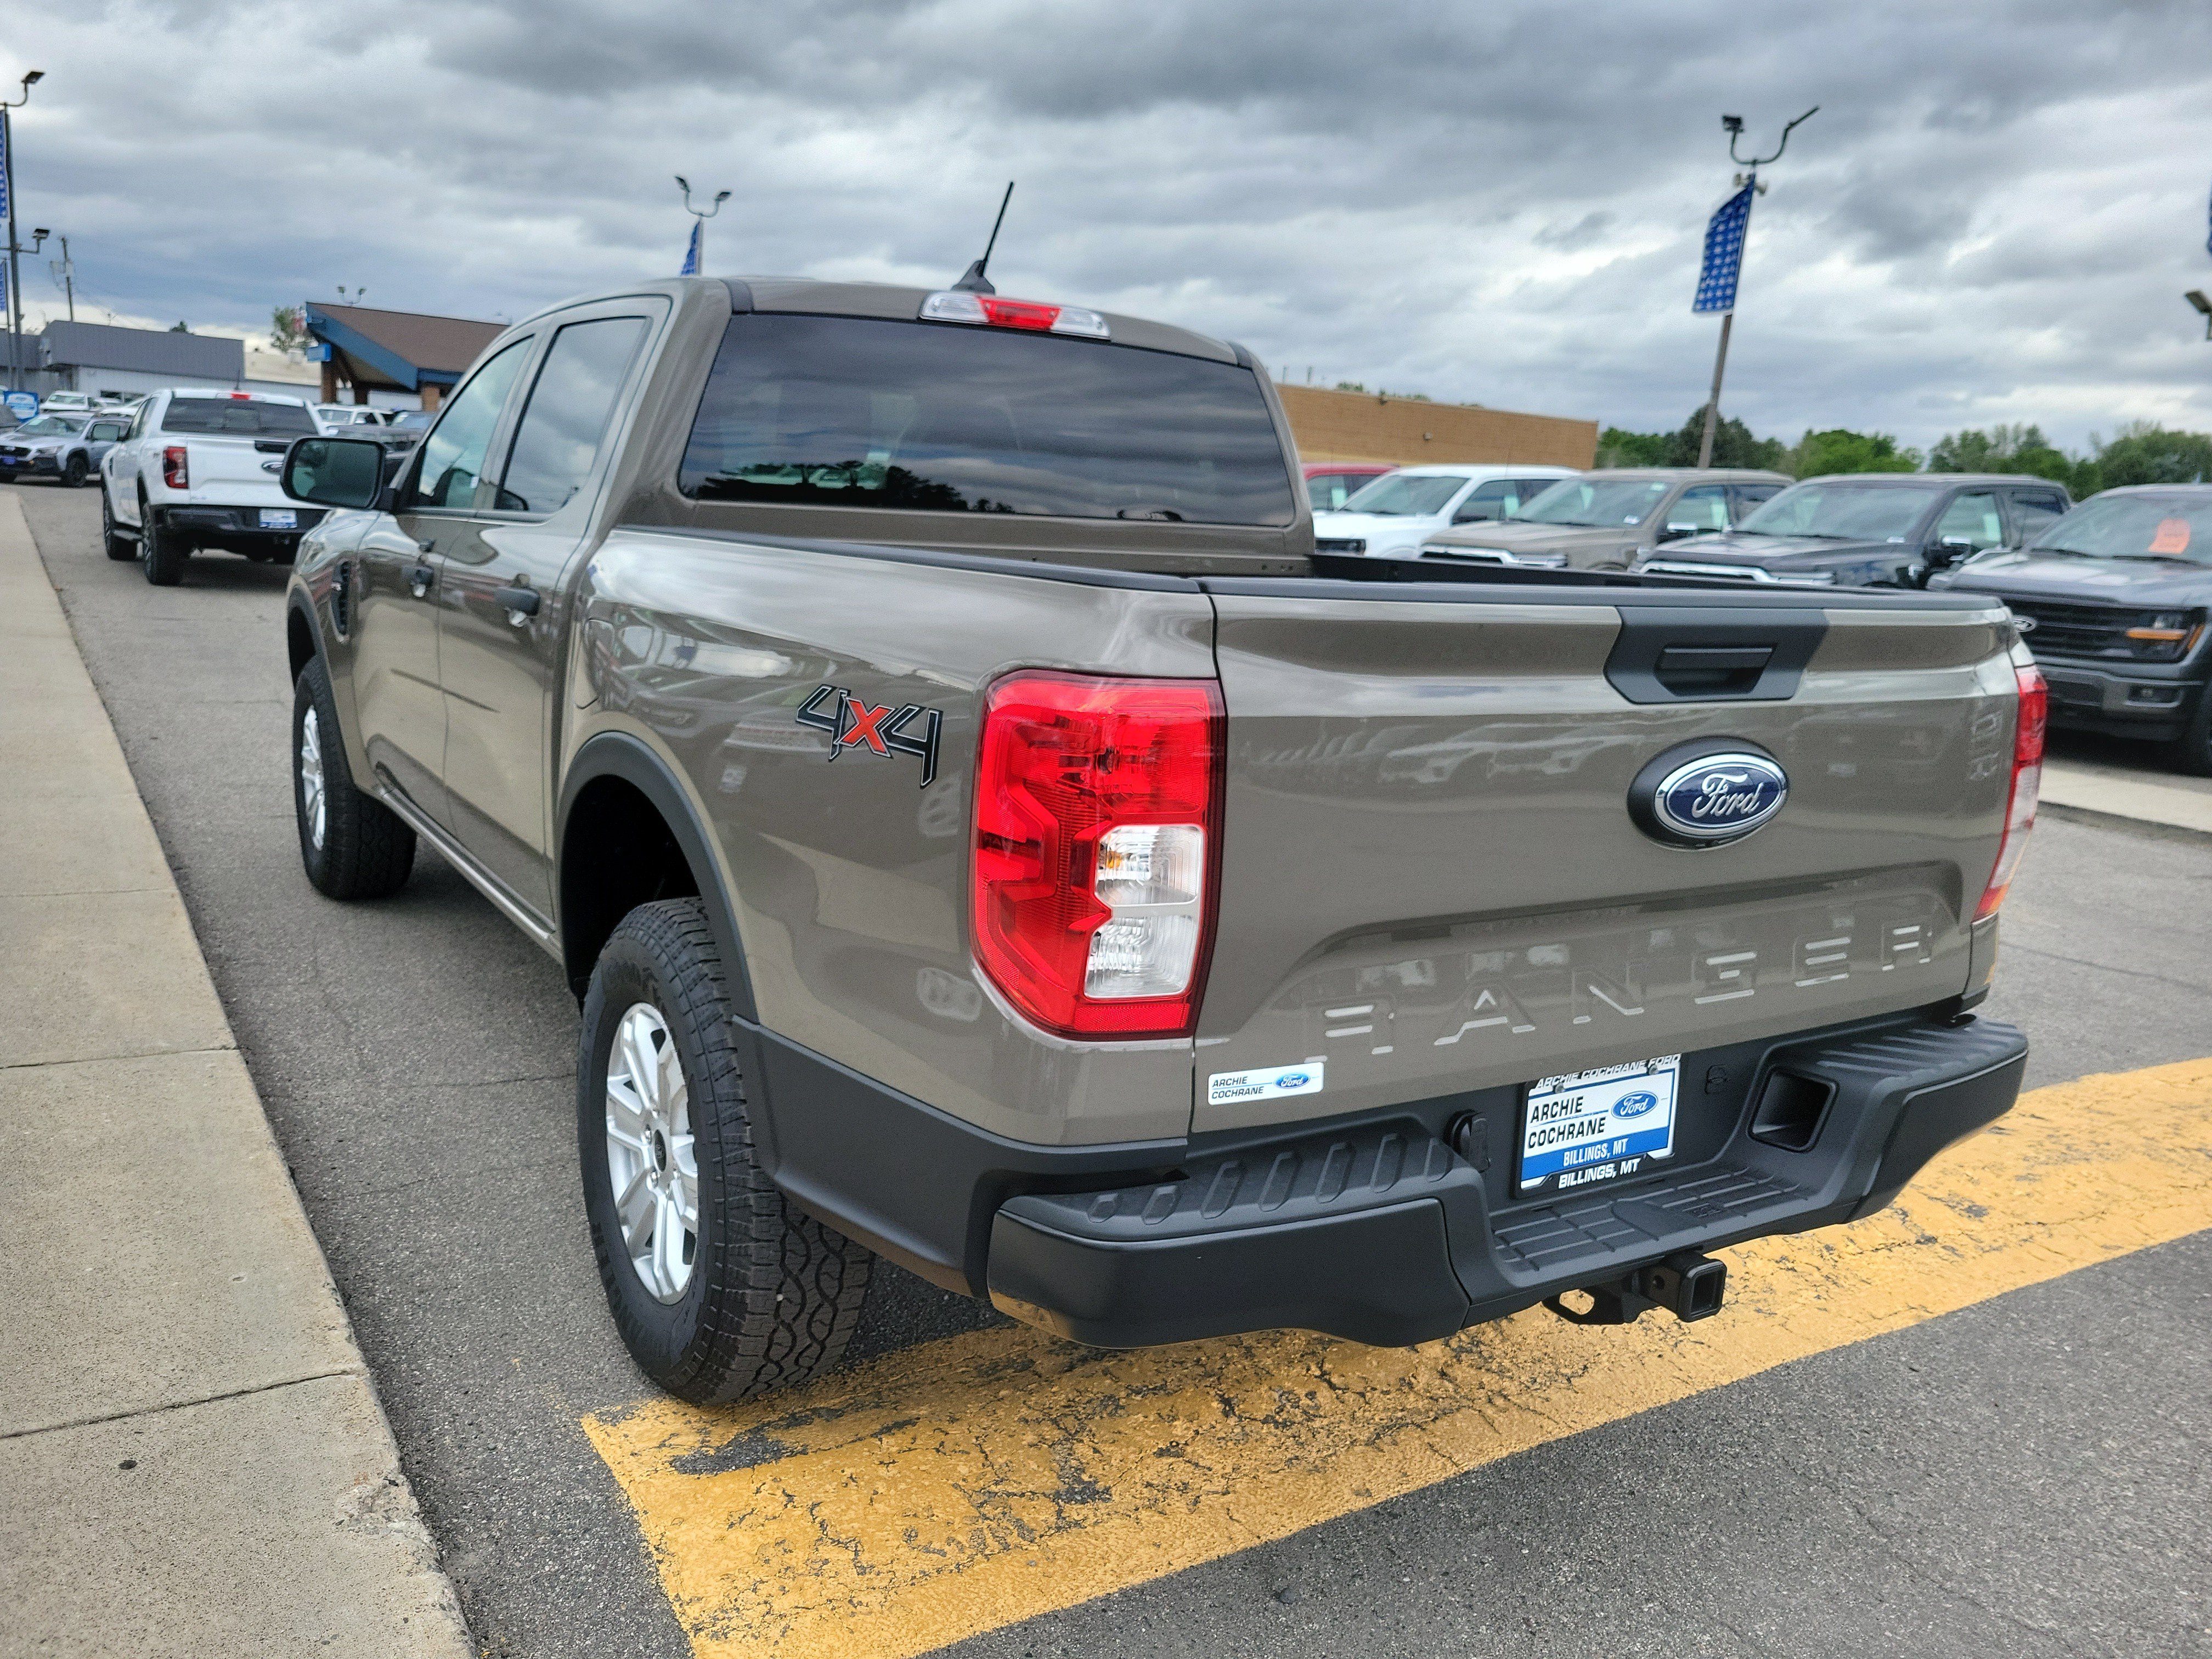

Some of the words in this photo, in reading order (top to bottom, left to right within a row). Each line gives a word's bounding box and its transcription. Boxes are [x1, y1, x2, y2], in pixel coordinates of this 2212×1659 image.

[1691, 772, 1764, 819] Ford
[1302, 919, 1933, 1063] RANGER
[1647, 1053, 1682, 1069] FORD
[1211, 1086, 1265, 1099] COCHRANE
[1212, 1076, 1248, 1088] ARCHIE
[1280, 1074, 1304, 1087] Ford
[1530, 1096, 1584, 1124] ARCHIE
[1620, 1096, 1647, 1116] Ford
[1528, 1116, 1606, 1149] COCHRANE
[1564, 1139, 1610, 1166] BILLINGS,
[1613, 1138, 1629, 1155] MT
[1558, 1164, 1617, 1189] BILLINGS,
[1620, 1158, 1641, 1174] MT
